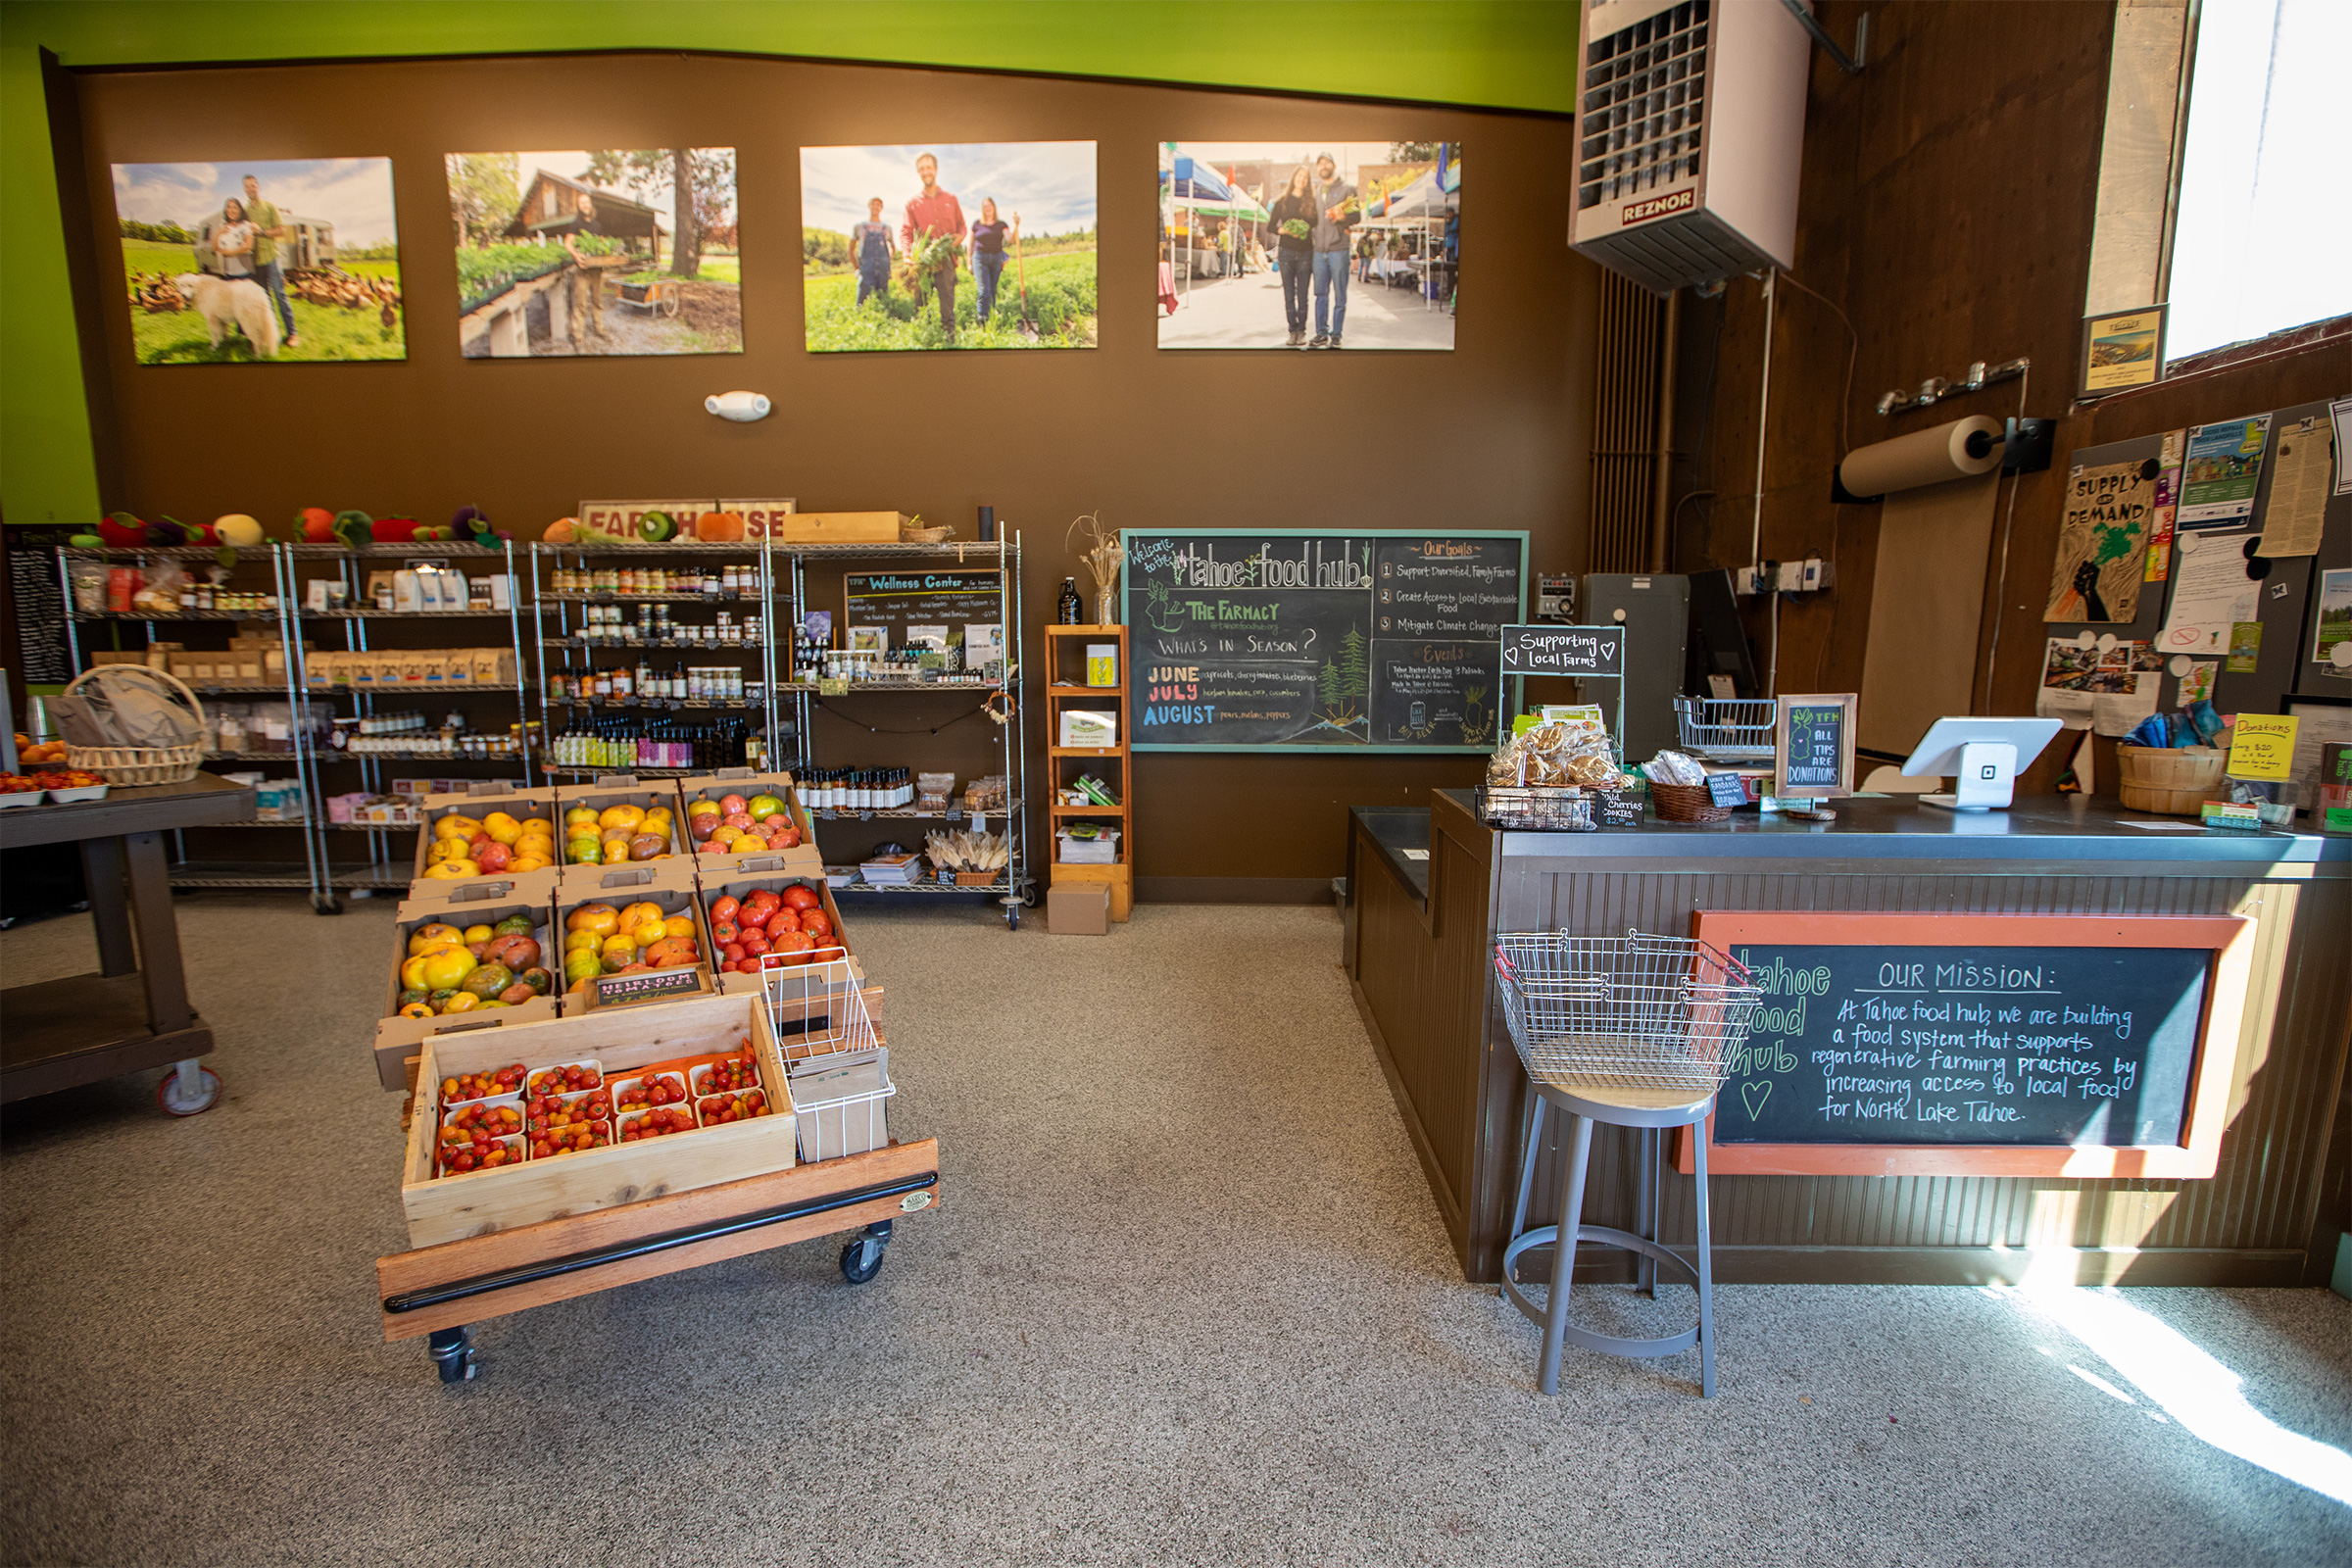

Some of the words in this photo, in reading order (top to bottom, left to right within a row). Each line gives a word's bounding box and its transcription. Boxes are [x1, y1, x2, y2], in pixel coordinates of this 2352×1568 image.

[1624, 192, 1692, 221] REZNOR
[2077, 473, 2143, 497] SUPPLY
[2068, 503, 2145, 525] DEMAND
[590, 511, 787, 537] FARHSE
[1424, 540, 1445, 556] Our
[1446, 540, 1473, 559] Goals
[1184, 542, 1245, 587] tahoe
[1255, 541, 1310, 588] food
[1316, 540, 1361, 588] hub
[1396, 564, 1431, 580] Support
[1493, 565, 1516, 578] Farms
[869, 575, 920, 590] Wellness
[924, 574, 962, 589] Center
[1396, 590, 1422, 603] Create
[1448, 593, 1456, 604] to
[1458, 592, 1477, 605] Local
[1478, 593, 1518, 605] Sustainable
[1185, 601, 1215, 620] THE
[1218, 600, 1281, 620] FARMACY
[1438, 604, 1458, 613] Food
[1397, 617, 1435, 635] Mitigate
[1436, 619, 1468, 632] Climate
[1469, 619, 1500, 637] Change
[1158, 638, 1208, 655] WHAT'S
[1219, 639, 1235, 652] IN
[1423, 644, 1464, 663] Events
[1520, 633, 1597, 658] Supporting
[1529, 651, 1560, 667] Local
[1562, 652, 1596, 668] Farms
[1148, 666, 1200, 683] JUNE
[1149, 684, 1198, 702] JULY
[1144, 706, 1215, 725] AUGUST
[1816, 712, 1839, 722] TFH
[1814, 730, 1833, 741] ALL
[2237, 720, 2291, 733] Donations
[1813, 745, 1836, 756] TIPS
[1811, 757, 1833, 766] ARE
[1788, 765, 1838, 782] DONATIONS
[1602, 808, 1634, 818] COOKIES
[1607, 801, 1642, 811] Cherries
[602, 973, 691, 991] HEIRLOOM
[1879, 962, 1925, 987] OUR
[603, 980, 693, 995] TOMATOES
[1838, 999, 1859, 1022] At
[1862, 996, 1908, 1021] Tahoe
[1912, 1000, 1950, 1022] food
[1957, 1003, 1991, 1026] hub,
[1998, 1005, 2022, 1023] we
[2029, 1009, 2057, 1025] are
[2063, 1004, 2132, 1040] building
[1833, 1028, 1845, 1044] a
[1851, 1023, 1892, 1050] food
[1901, 1029, 1966, 1054] system
[1969, 1029, 2012, 1050] that
[2016, 1032, 2094, 1056] supports
[1732, 1040, 1798, 1076] hub
[1812, 1048, 1922, 1077] regenerative
[1929, 1049, 2006, 1085] farming
[2018, 1056, 2102, 1077] practices
[2114, 1057, 2137, 1090] by
[1826, 1076, 1912, 1107] increasing
[1922, 1077, 1985, 1092] access
[1993, 1078, 2015, 1096] to
[2027, 1076, 2069, 1098] local
[2078, 1076, 2121, 1100] food
[1819, 1095, 1851, 1121] for
[1855, 1098, 1908, 1121] North
[1917, 1098, 1960, 1123] Lake
[1963, 1101, 2027, 1122] Tahoe.
